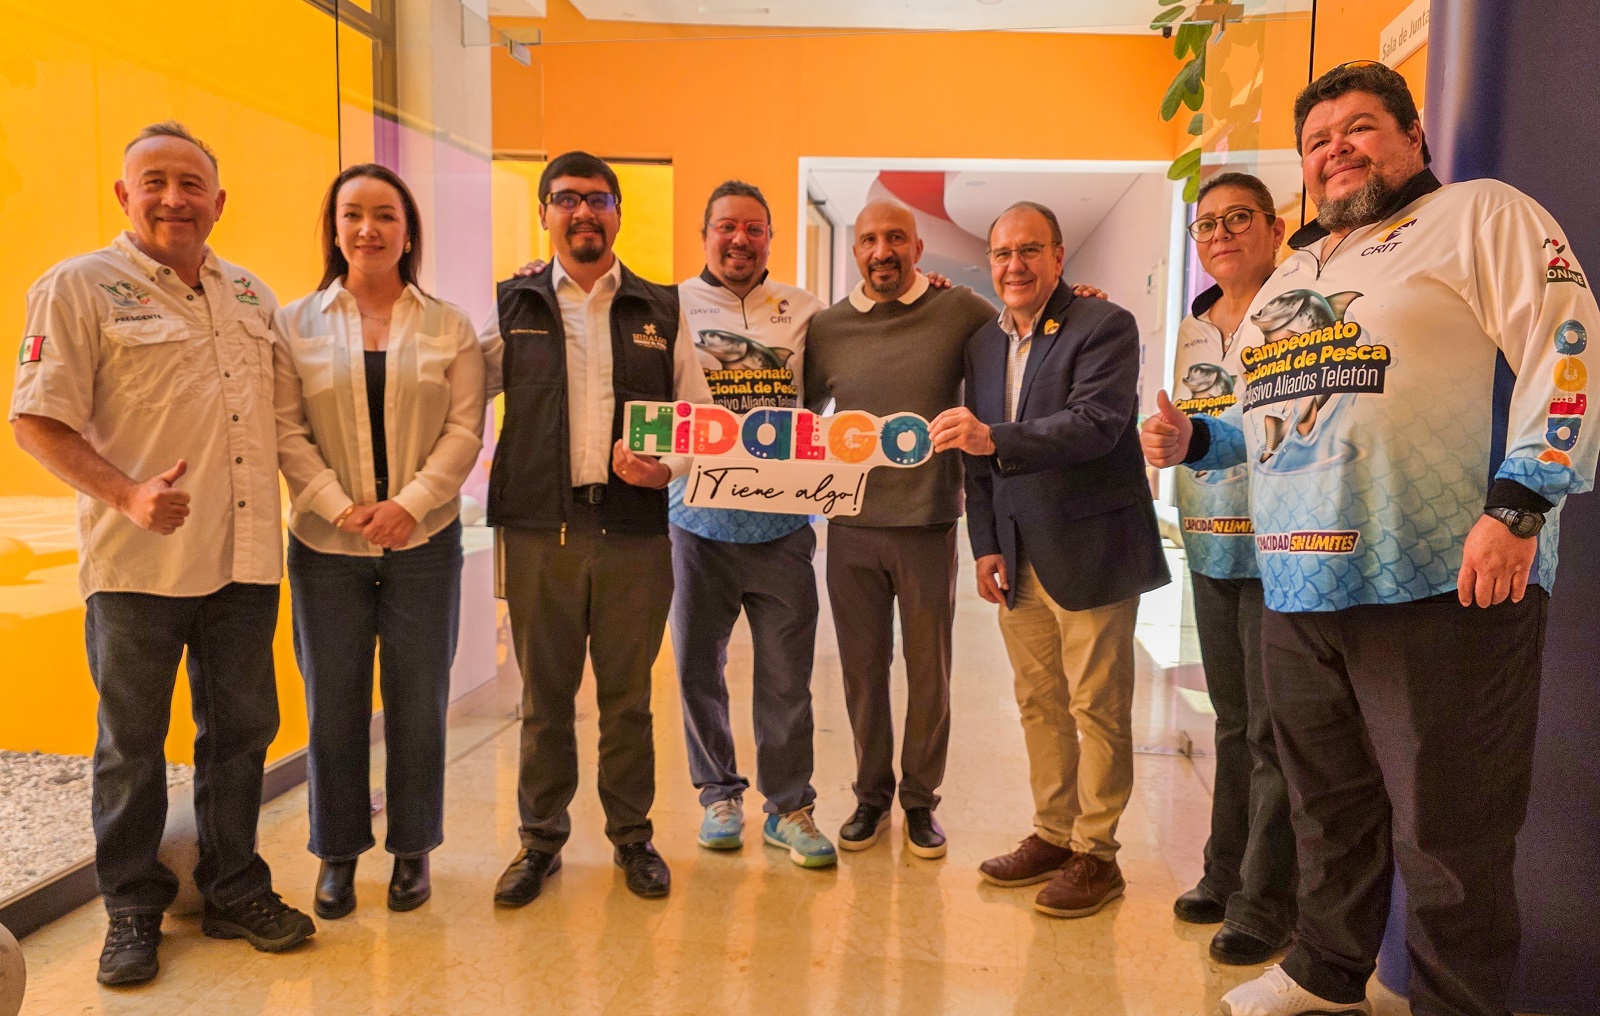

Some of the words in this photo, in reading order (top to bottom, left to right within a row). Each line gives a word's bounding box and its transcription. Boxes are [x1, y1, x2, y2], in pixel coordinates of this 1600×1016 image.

[1382, 36, 1397, 61] Sala
[1398, 27, 1407, 47] de
[1409, 9, 1430, 38] Junta
[1361, 241, 1402, 257] CRIT
[770, 316, 792, 324] CRIT
[1241, 320, 1358, 365] Campeonato
[1293, 350, 1318, 370] de
[1320, 345, 1387, 364] Pesca
[703, 367, 793, 383] Campeonato
[1273, 371, 1317, 398] Aliados
[1321, 364, 1379, 389] Teletón
[710, 382, 752, 395] cional
[754, 382, 772, 394] de
[690, 465, 784, 503] ¡Tiene
[795, 472, 865, 514] algo!
[1305, 533, 1354, 550] LÍMITES
